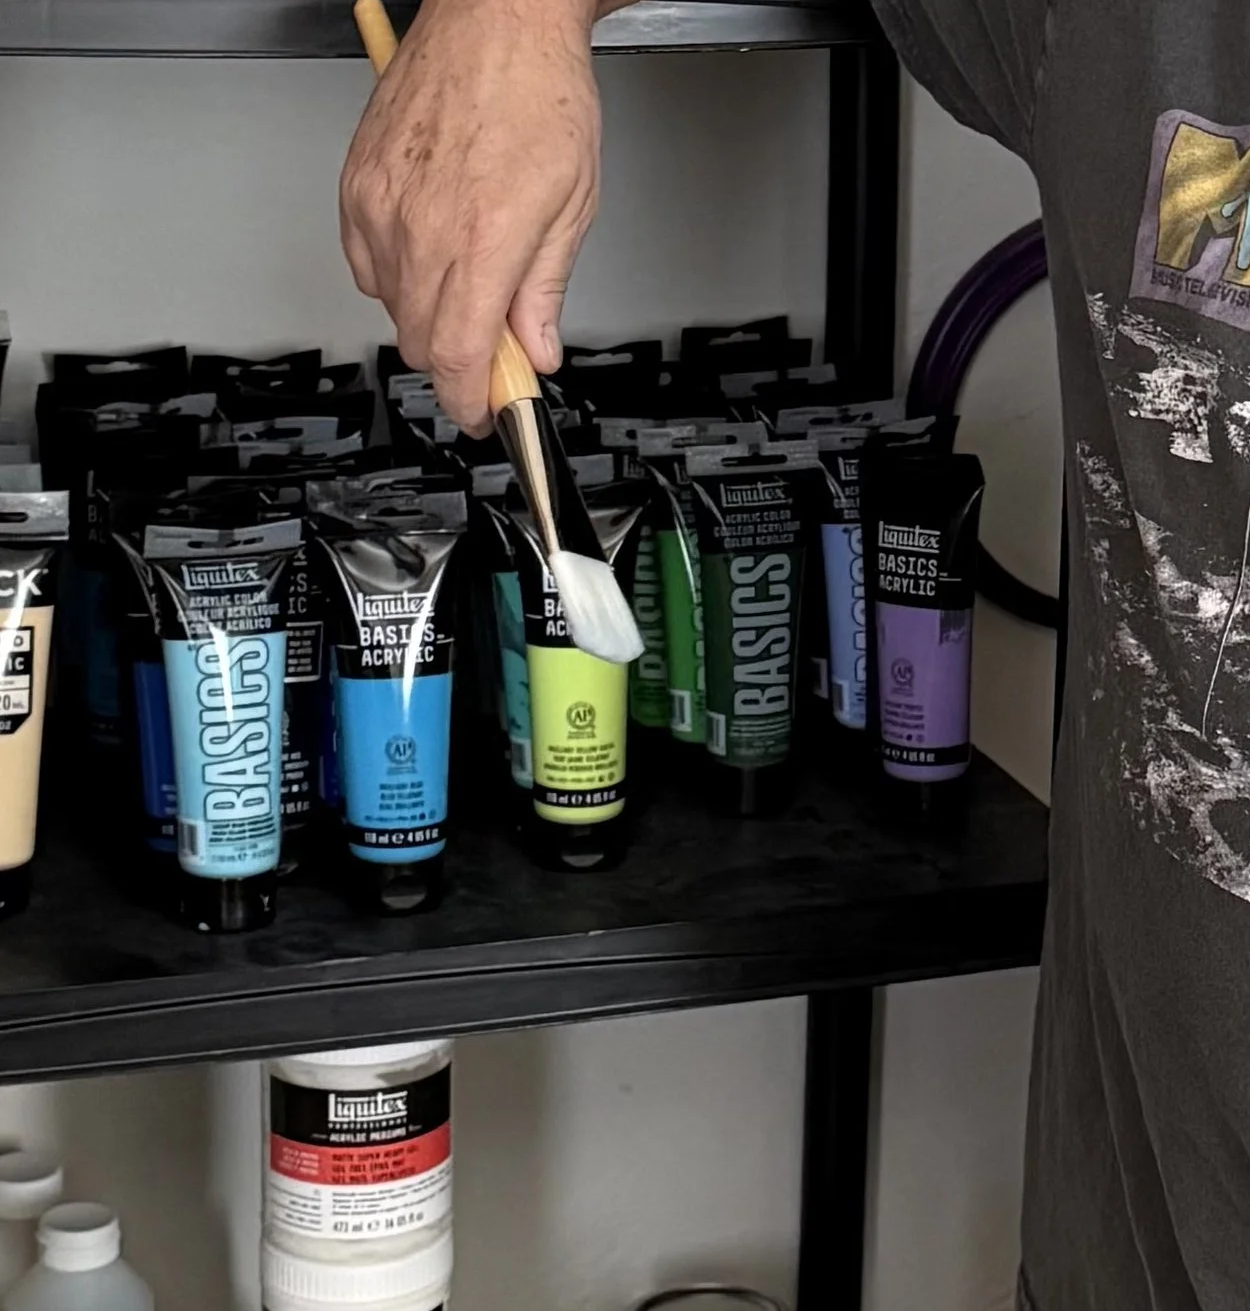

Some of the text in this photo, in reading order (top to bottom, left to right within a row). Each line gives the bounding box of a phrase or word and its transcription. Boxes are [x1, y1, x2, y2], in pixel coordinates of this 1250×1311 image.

[720, 480, 793, 508] Liquitex
[878, 520, 942, 553] Liquitex
[180, 561, 270, 591] Liquitex
[878, 552, 939, 578] BASICS
[879, 574, 937, 597] ACRYLIC
[359, 622, 436, 647] BASIS
[729, 552, 792, 717] BASICS
[360, 645, 435, 667] ACRYIC
[195, 637, 273, 823] BASICS
[329, 1090, 408, 1122] Liquitex
